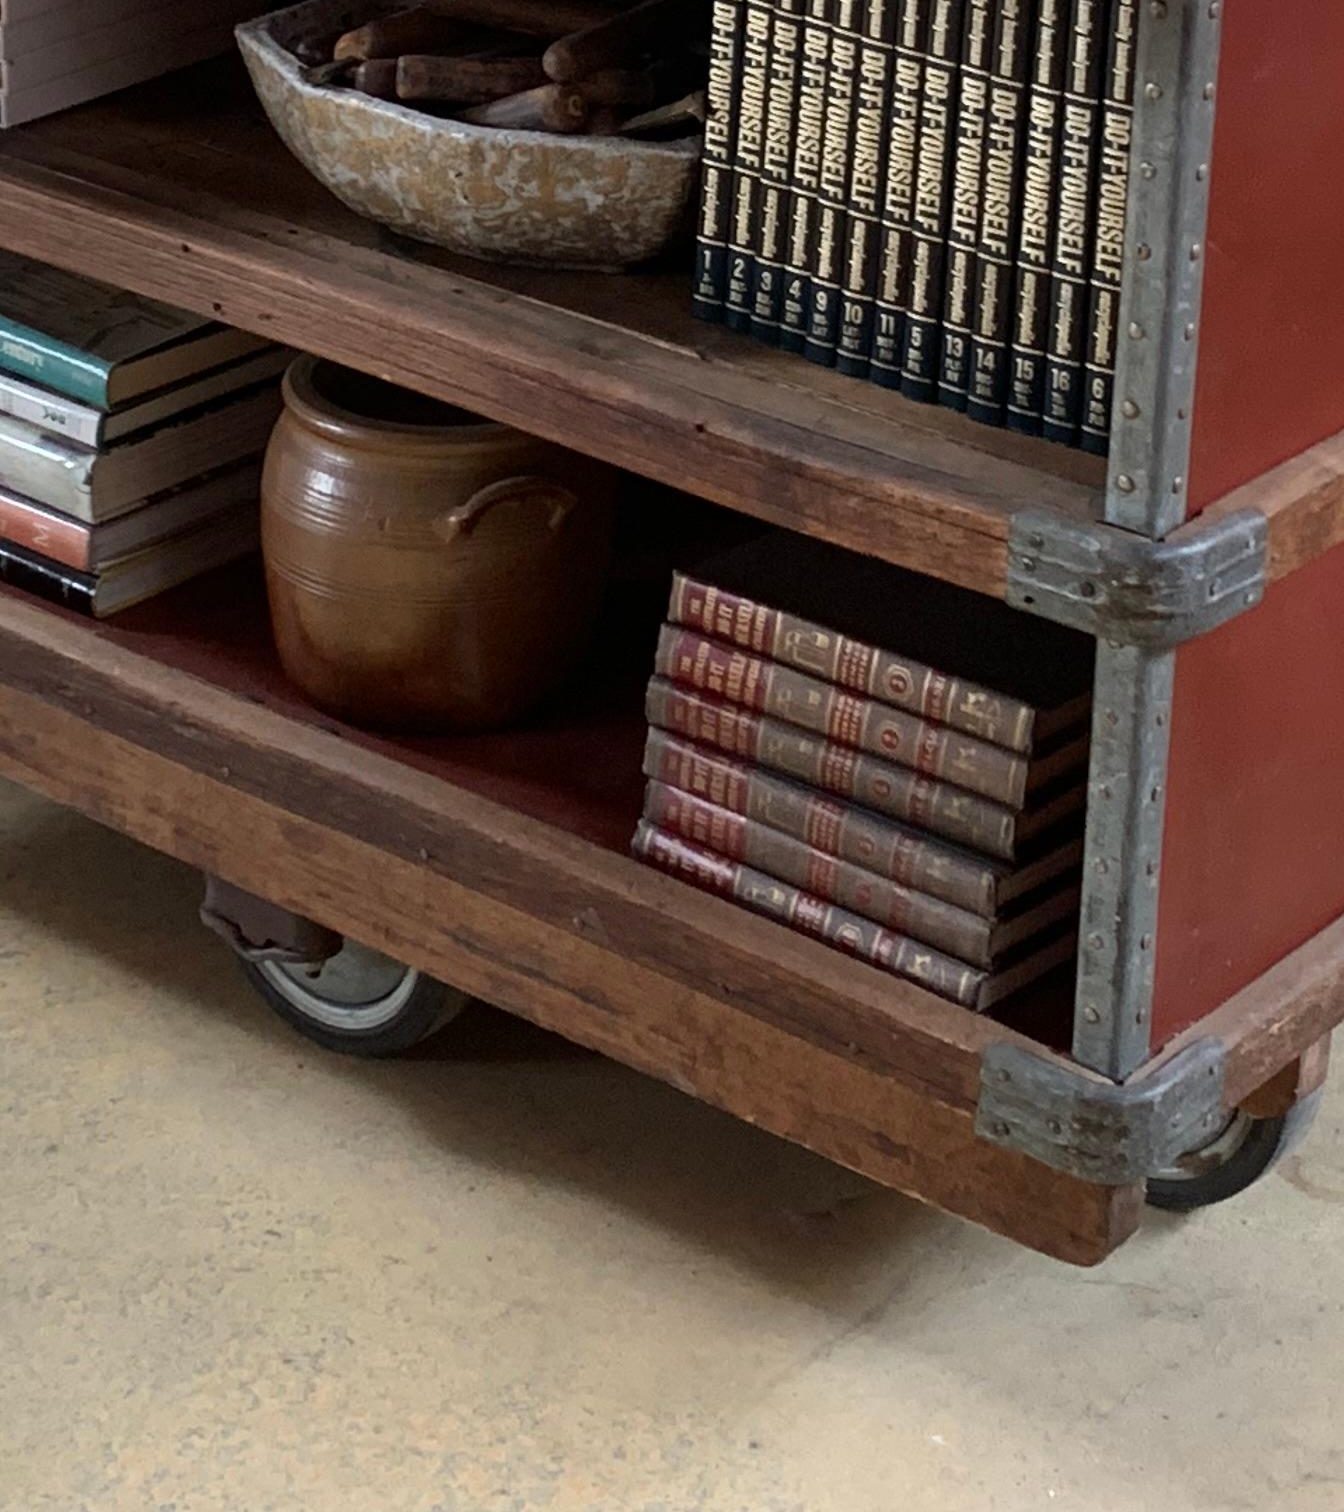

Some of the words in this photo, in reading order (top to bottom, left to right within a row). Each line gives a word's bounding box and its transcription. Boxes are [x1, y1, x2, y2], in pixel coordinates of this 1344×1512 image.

[705, 1, 736, 160] DO-IT-YOURSELF
[737, 9, 770, 168] DO-IT-YOURSELF
[764, 22, 797, 181] DO-IT-YOURSELF
[794, 28, 828, 189] DO-IT-YOURSELF
[820, 39, 855, 201] DO-IT-YOURSELF
[850, 50, 886, 218] DO-IT-YOURSELF
[885, 57, 919, 221] DO-IT-YOURSELF
[914, 65, 948, 233] DO-IT-YOURSELF
[951, 77, 986, 243] DO-IT-YOURSELF
[982, 87, 1017, 257] DO-IT-YOURSELF
[1021, 94, 1055, 265] DO-IT-YOURSELF
[1057, 105, 1091, 275] DO-IT-YOURSELF
[1095, 112, 1130, 283] DO-IT-YOURSELF
[704, 250, 711, 269] 1
[734, 259, 744, 278] 2
[761, 272, 772, 291] 3
[789, 280, 801, 298] 4
[816, 291, 827, 311] 9
[844, 302, 862, 324] 10
[881, 314, 894, 335] 11
[911, 327, 922, 347] 5
[946, 335, 963, 358] 13
[976, 348, 995, 370] 14
[1016, 358, 1034, 379] 15
[1051, 368, 1070, 390] 16
[1092, 378, 1104, 398] 6
